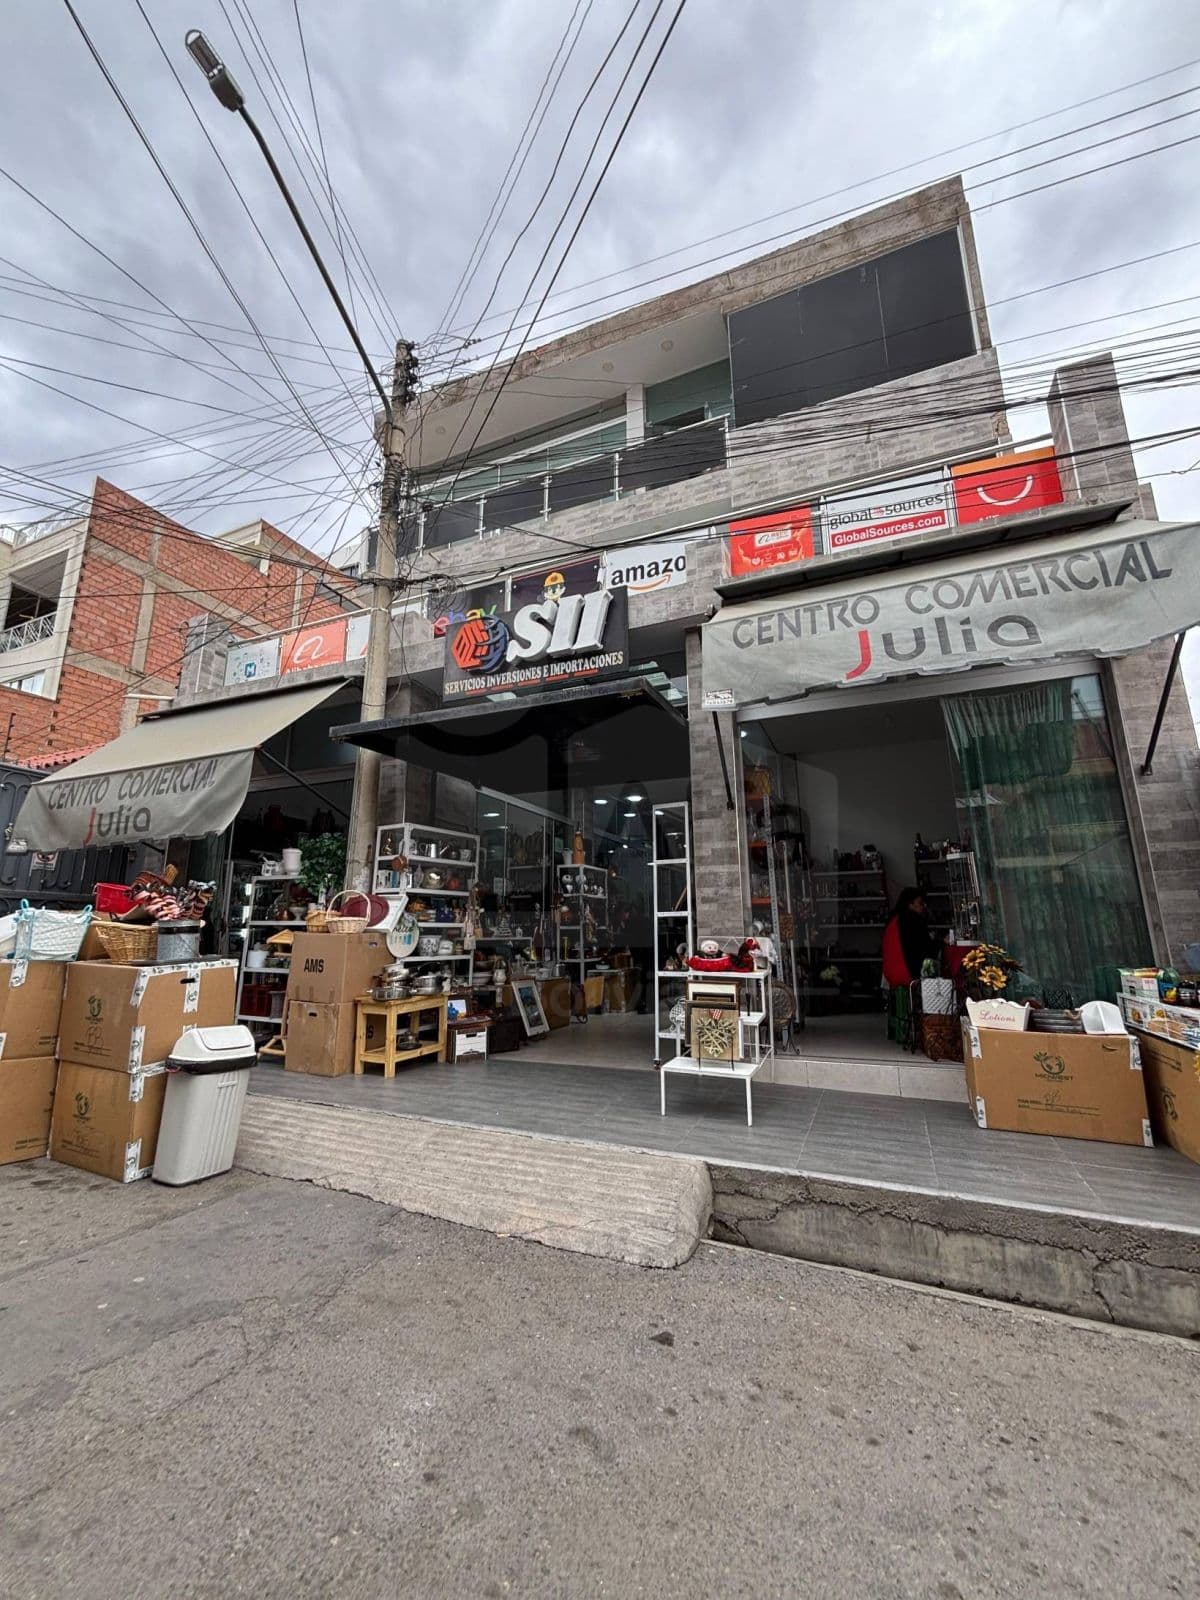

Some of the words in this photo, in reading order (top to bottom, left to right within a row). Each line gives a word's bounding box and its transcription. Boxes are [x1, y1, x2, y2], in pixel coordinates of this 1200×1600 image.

[830, 508, 872, 529] global
[885, 494, 944, 516] sources
[834, 514, 944, 545] GlobalSources.com
[610, 555, 686, 586] amazo
[732, 594, 881, 649] CENTRO
[904, 540, 1172, 615] COMERCIAL
[845, 614, 1042, 681] Julia
[444, 676, 486, 695] SERVICIOS
[486, 665, 542, 688] INVERSIONES
[542, 664, 549, 678] E
[550, 651, 624, 675] IMPORTACIONES
[48, 776, 111, 810] CENTRO
[117, 758, 219, 802] COMERCIAL
[83, 805, 152, 847] Julia
[303, 958, 325, 974] AMS
